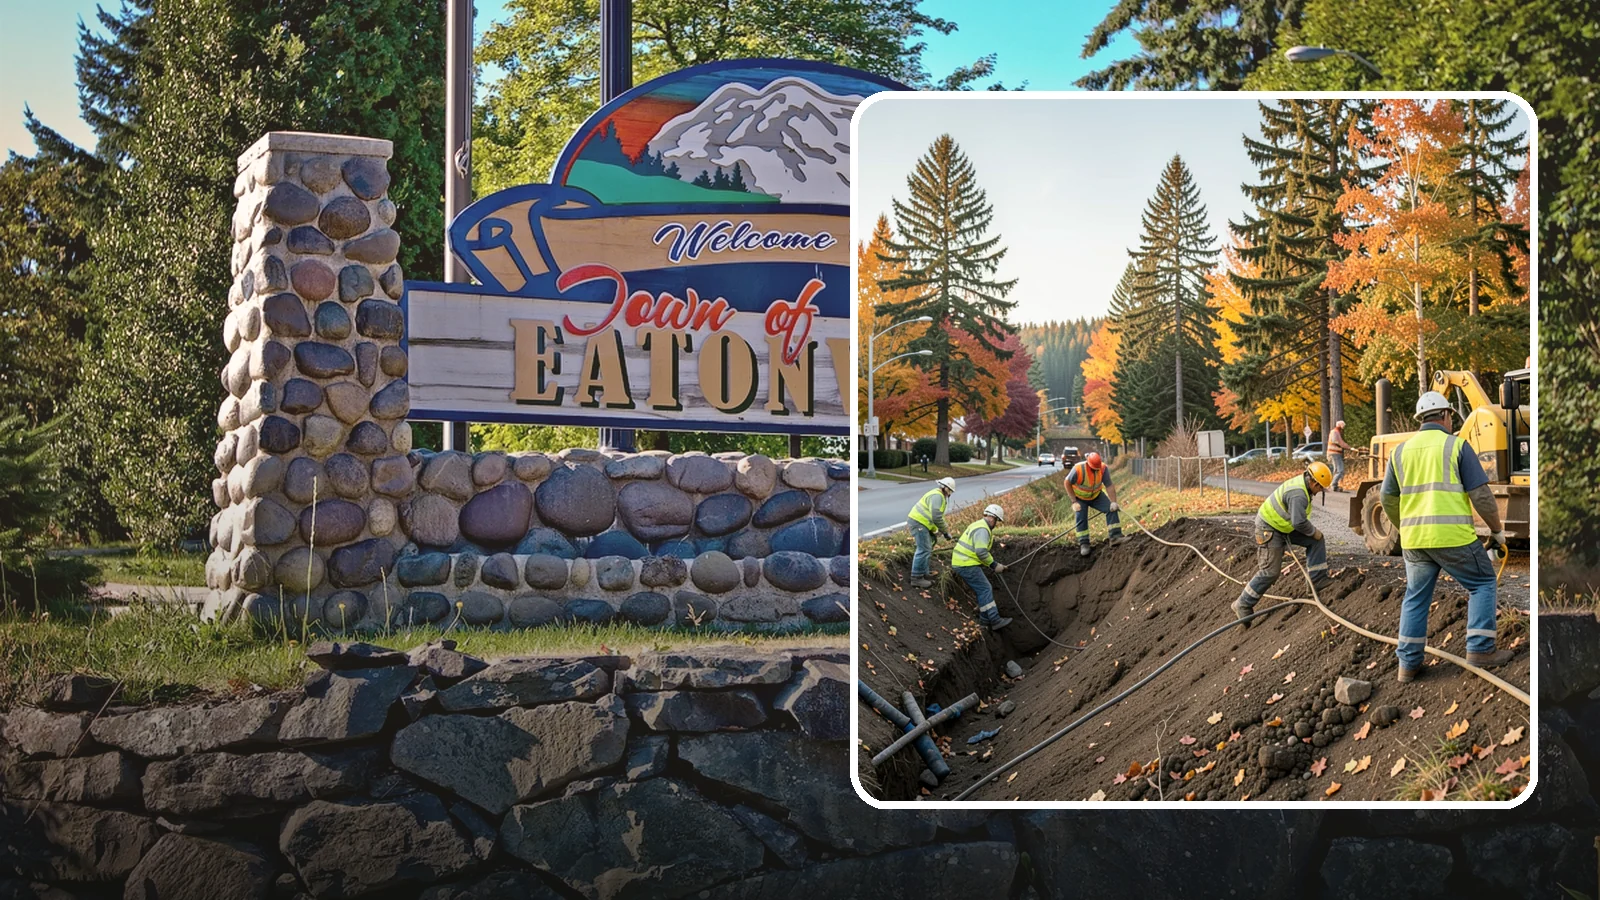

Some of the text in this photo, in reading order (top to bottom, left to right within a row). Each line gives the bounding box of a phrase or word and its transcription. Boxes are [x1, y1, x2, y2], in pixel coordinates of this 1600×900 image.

[654, 222, 836, 262] Welcome
[557, 265, 826, 363] Town of
